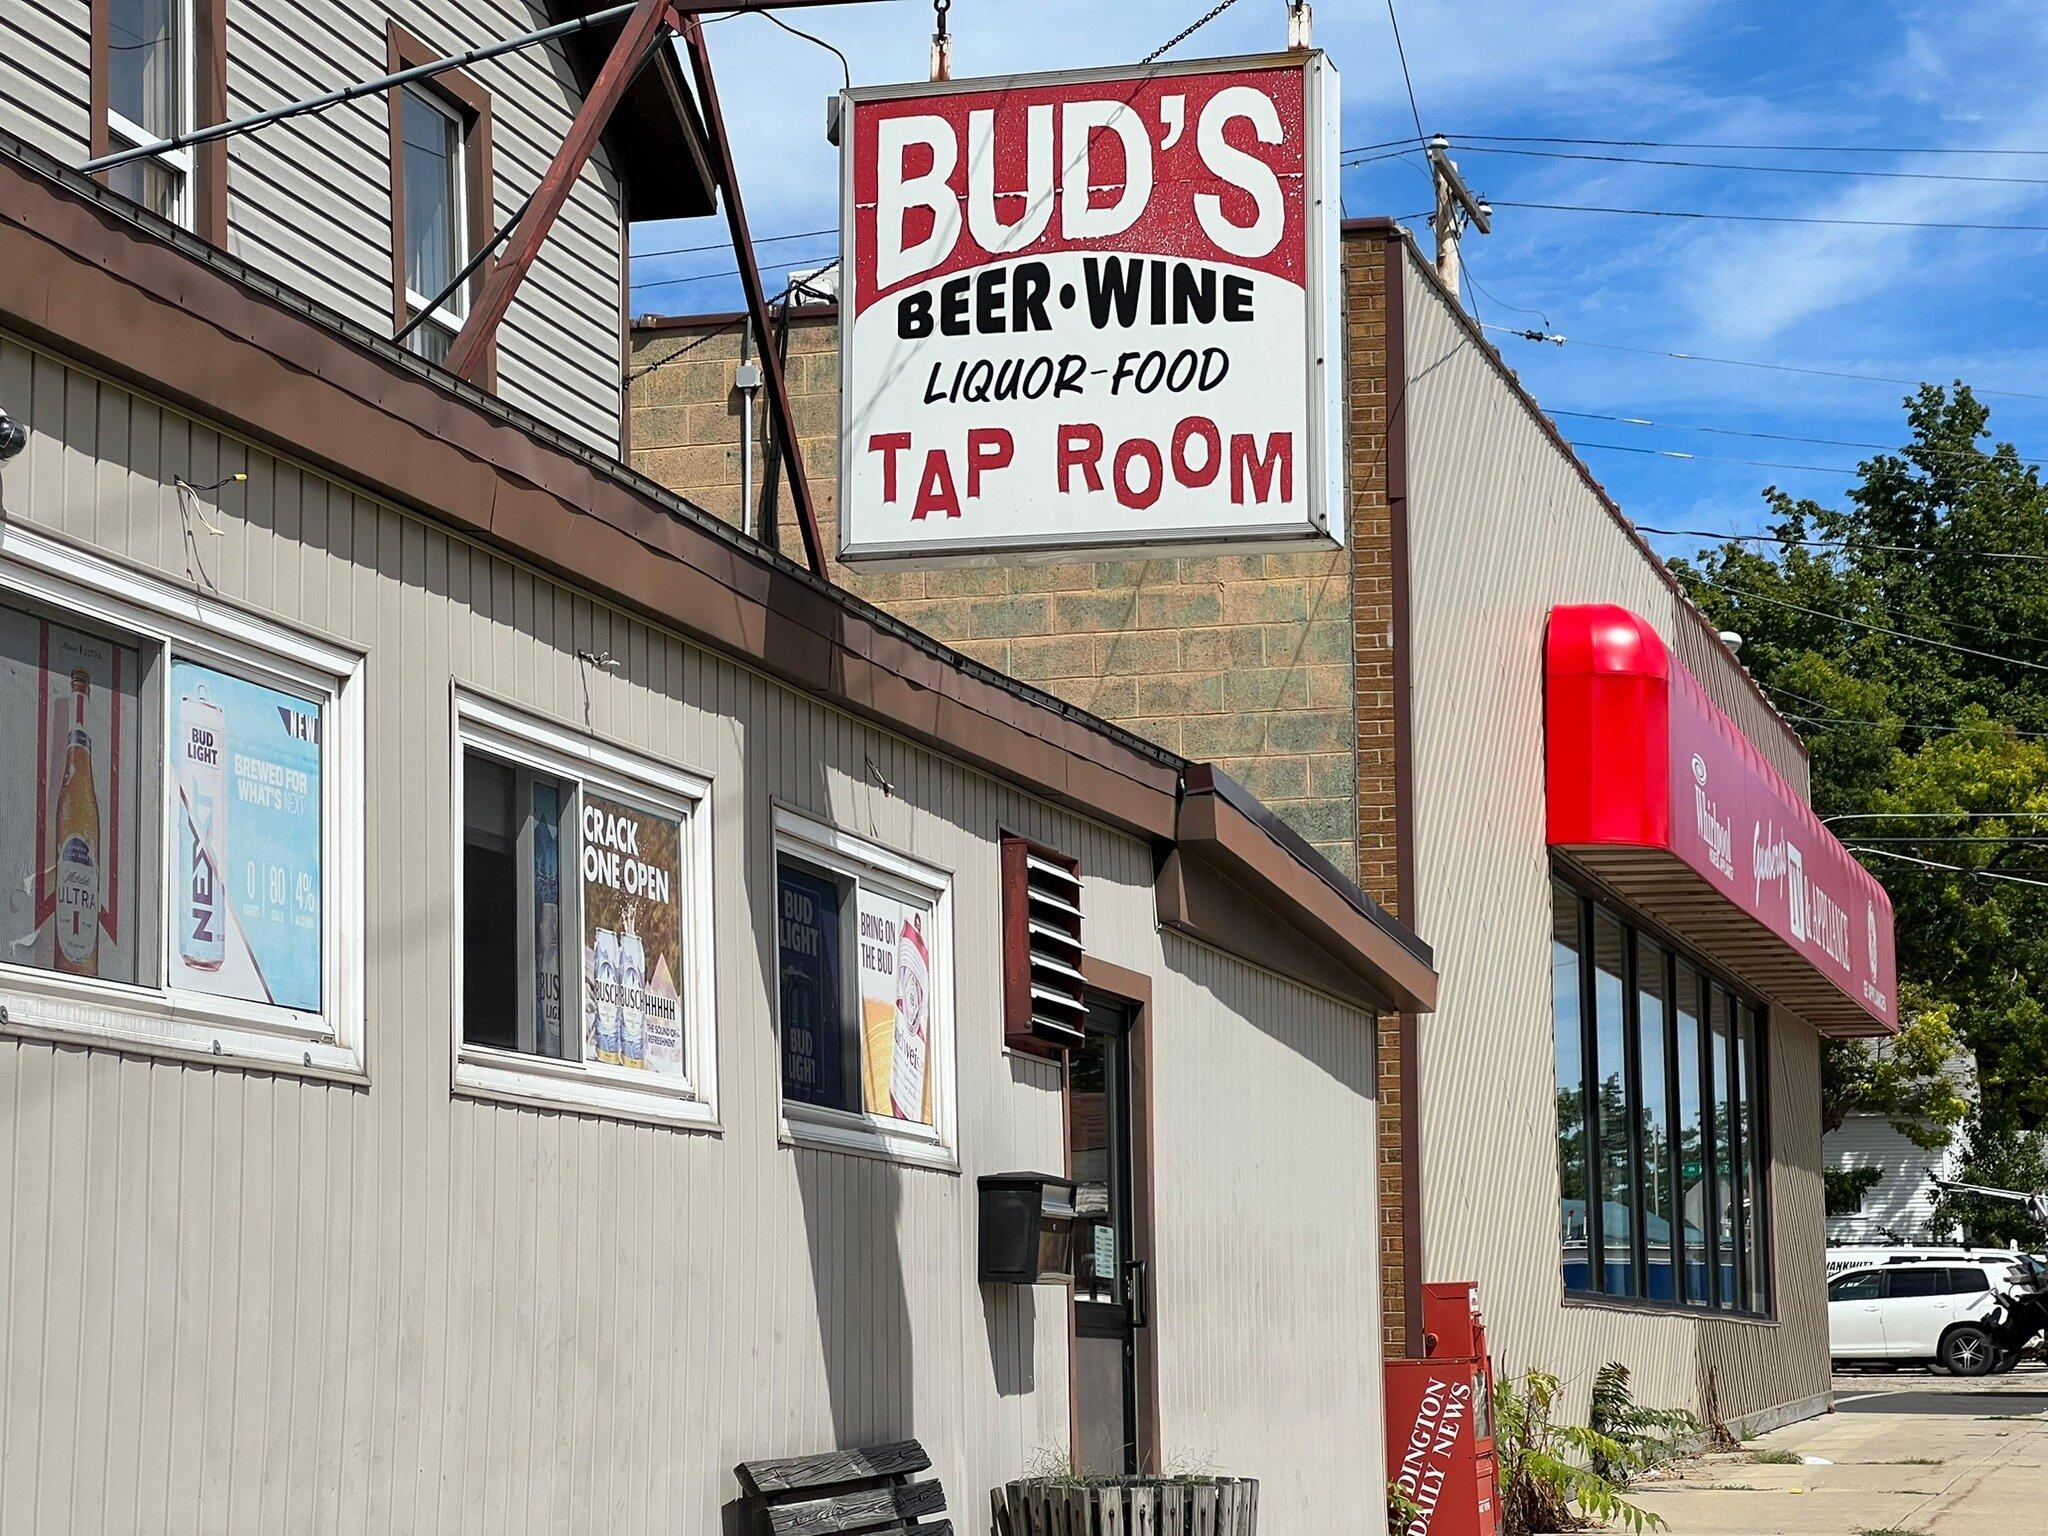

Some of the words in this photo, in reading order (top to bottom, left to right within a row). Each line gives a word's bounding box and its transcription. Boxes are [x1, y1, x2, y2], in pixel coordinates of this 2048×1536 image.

[876, 86, 1286, 291] BUD'S
[867, 427, 1015, 521] TAP
[1055, 415, 1293, 510] ROOM
[191, 727, 214, 748] BUD
[290, 710, 317, 743] NEW
[187, 742, 218, 765] LIGHT
[234, 753, 284, 787] BREWED
[285, 766, 308, 795] FOR
[237, 778, 283, 810] WHAT'S
[583, 805, 639, 857] CRACK
[247, 860, 256, 899] 0
[270, 866, 286, 906] 80
[295, 872, 315, 912] 4%
[584, 845, 620, 889] ONE
[624, 858, 668, 904] OPEN
[58, 886, 96, 910] ULTRA
[784, 890, 813, 926] BUD
[780, 917, 819, 957] LIGHT
[861, 911, 884, 942] BRING
[885, 920, 896, 946] ON
[861, 943, 876, 971] THE
[877, 947, 893, 975] BUD
[596, 980, 618, 1006] BUSCH
[620, 984, 645, 1012] BUSCH
[790, 1027, 813, 1056] BUD
[788, 1053, 816, 1084] LIGHT
[1407, 1462, 1445, 1536] DAILY
[1432, 1381, 1471, 1459] NEWS
